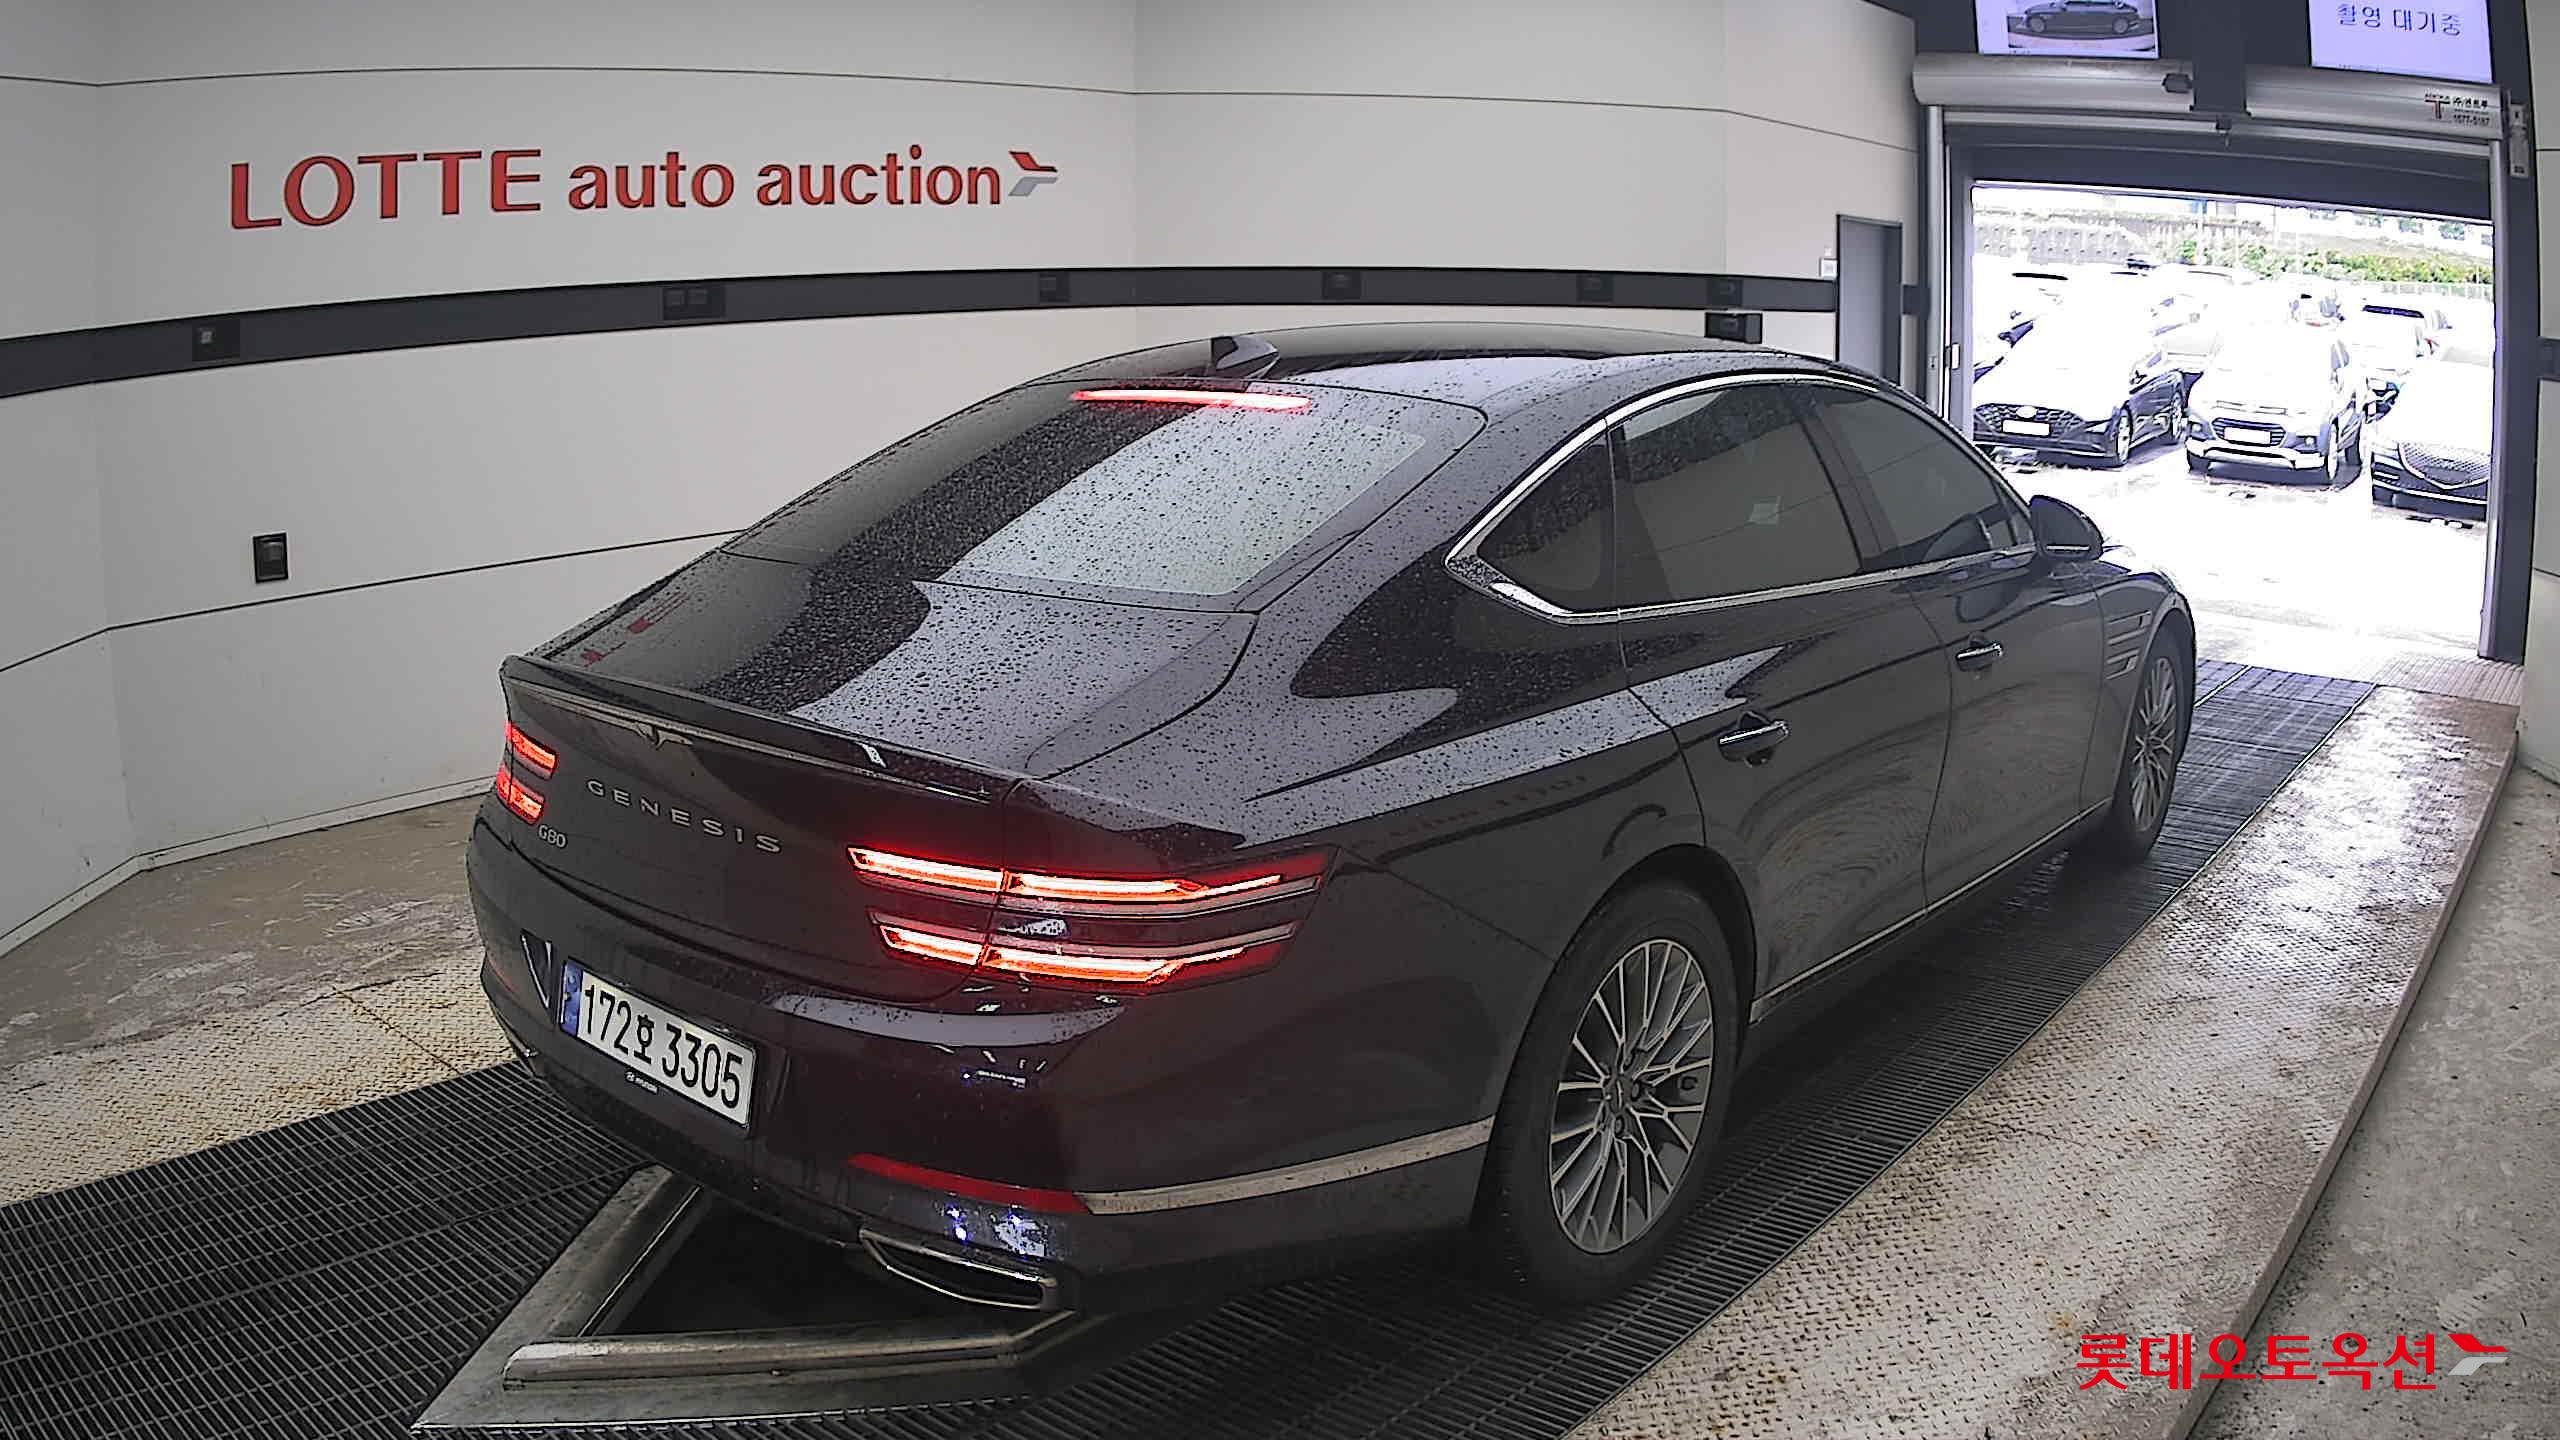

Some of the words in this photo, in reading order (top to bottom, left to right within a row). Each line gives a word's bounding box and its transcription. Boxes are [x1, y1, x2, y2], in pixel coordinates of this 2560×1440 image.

[2337, 3, 2381, 28] 촬영
[2393, 9, 2461, 36] 대기중
[230, 149, 541, 229] LOTTE
[568, 151, 734, 209] auto
[757, 145, 1001, 206] auction
[538, 824, 567, 848] G80
[586, 779, 783, 854] GENESIS
[662, 1023, 742, 1109] 3305
